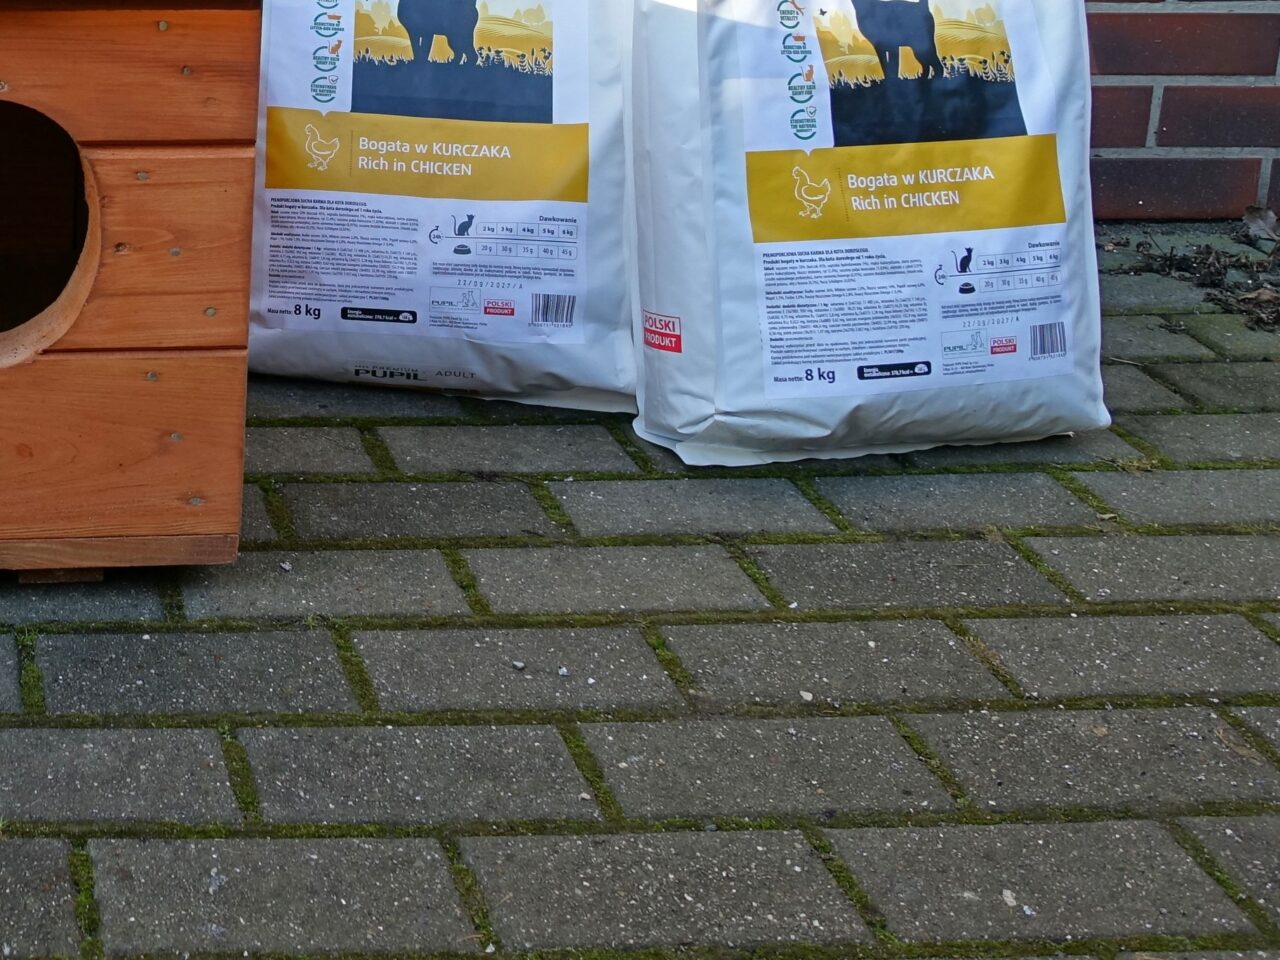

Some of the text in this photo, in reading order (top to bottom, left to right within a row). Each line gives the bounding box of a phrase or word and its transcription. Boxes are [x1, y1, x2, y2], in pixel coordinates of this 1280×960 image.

[358, 137, 511, 158] Bogata w KURCZAKA
[358, 156, 472, 176] Rich in CHICKEN
[847, 166, 995, 190] Bogata w KURCZAKA
[851, 190, 959, 210] Rich in CHICKEN
[539, 215, 577, 223] Dawkowanie
[294, 304, 301, 315] 8
[305, 304, 321, 320] kg
[645, 314, 675, 332] POLSKI
[354, 368, 476, 381] PUPIL ADULT
[805, 368, 814, 381] 8
[818, 367, 835, 384] kg
